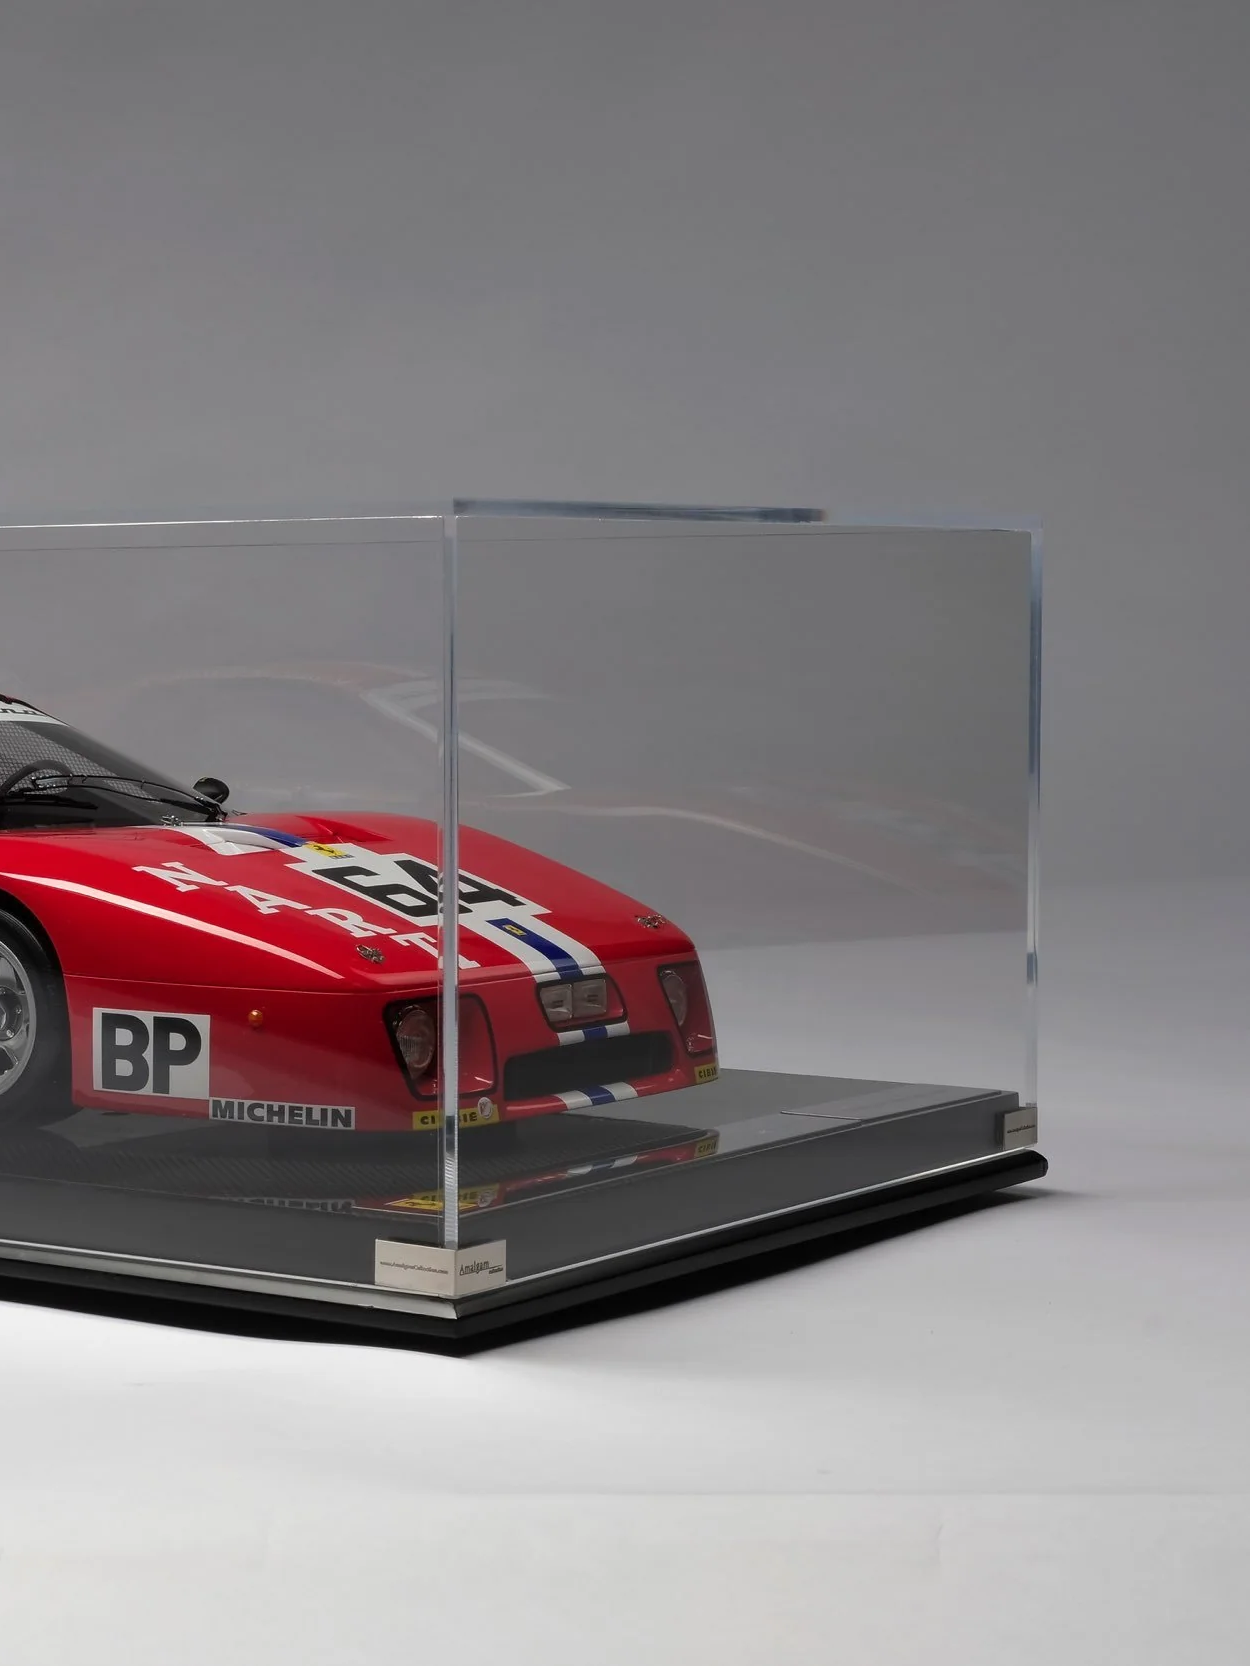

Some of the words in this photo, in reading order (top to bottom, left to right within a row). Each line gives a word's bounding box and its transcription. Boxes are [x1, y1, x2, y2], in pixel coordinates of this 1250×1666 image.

[312, 859, 526, 918] 64
[100, 1011, 202, 1095] BP
[211, 1099, 352, 1129] MICHELIN
[420, 1111, 478, 1125] CIIE
[459, 1260, 490, 1276] Amalgam
